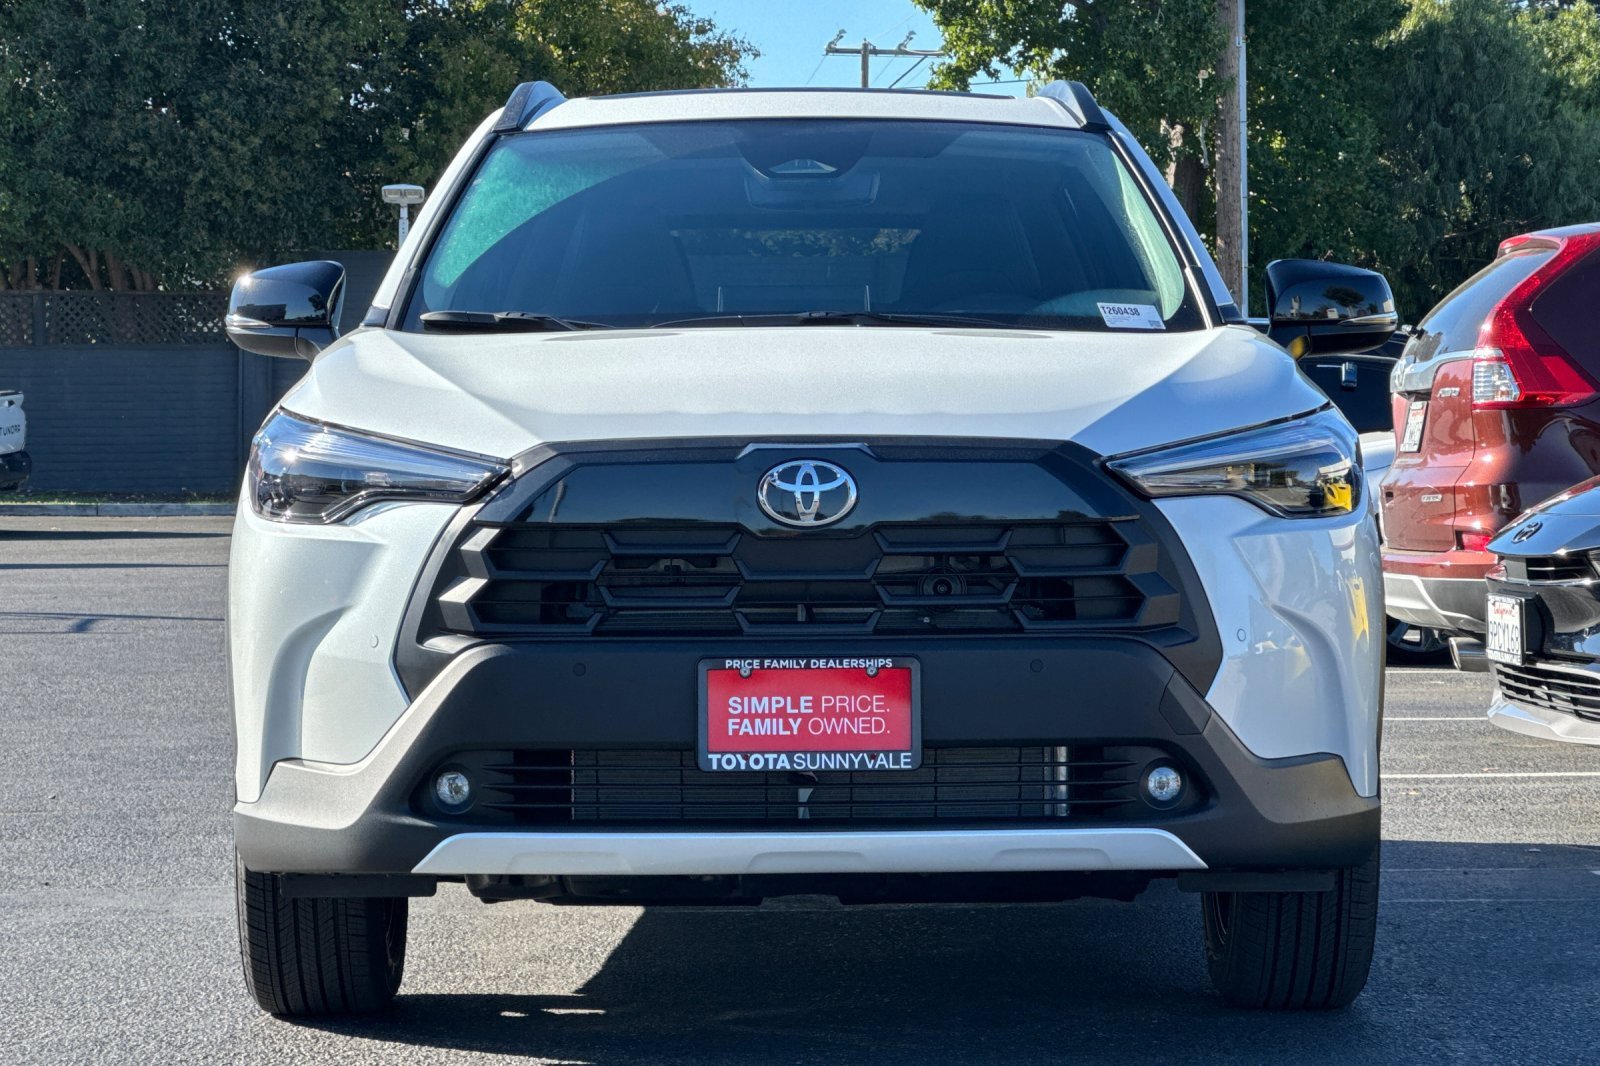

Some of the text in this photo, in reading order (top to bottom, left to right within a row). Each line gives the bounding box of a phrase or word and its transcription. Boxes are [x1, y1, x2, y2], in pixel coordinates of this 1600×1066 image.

[1100, 306, 1140, 316] T260438
[725, 658, 893, 669] PRICE FAMILY DEALERSHIPS
[728, 695, 890, 714] SIMPLE PRICE.
[727, 717, 891, 736] FAMILY OWNED.
[707, 752, 912, 770] TOYOTA SUNNYVALE
